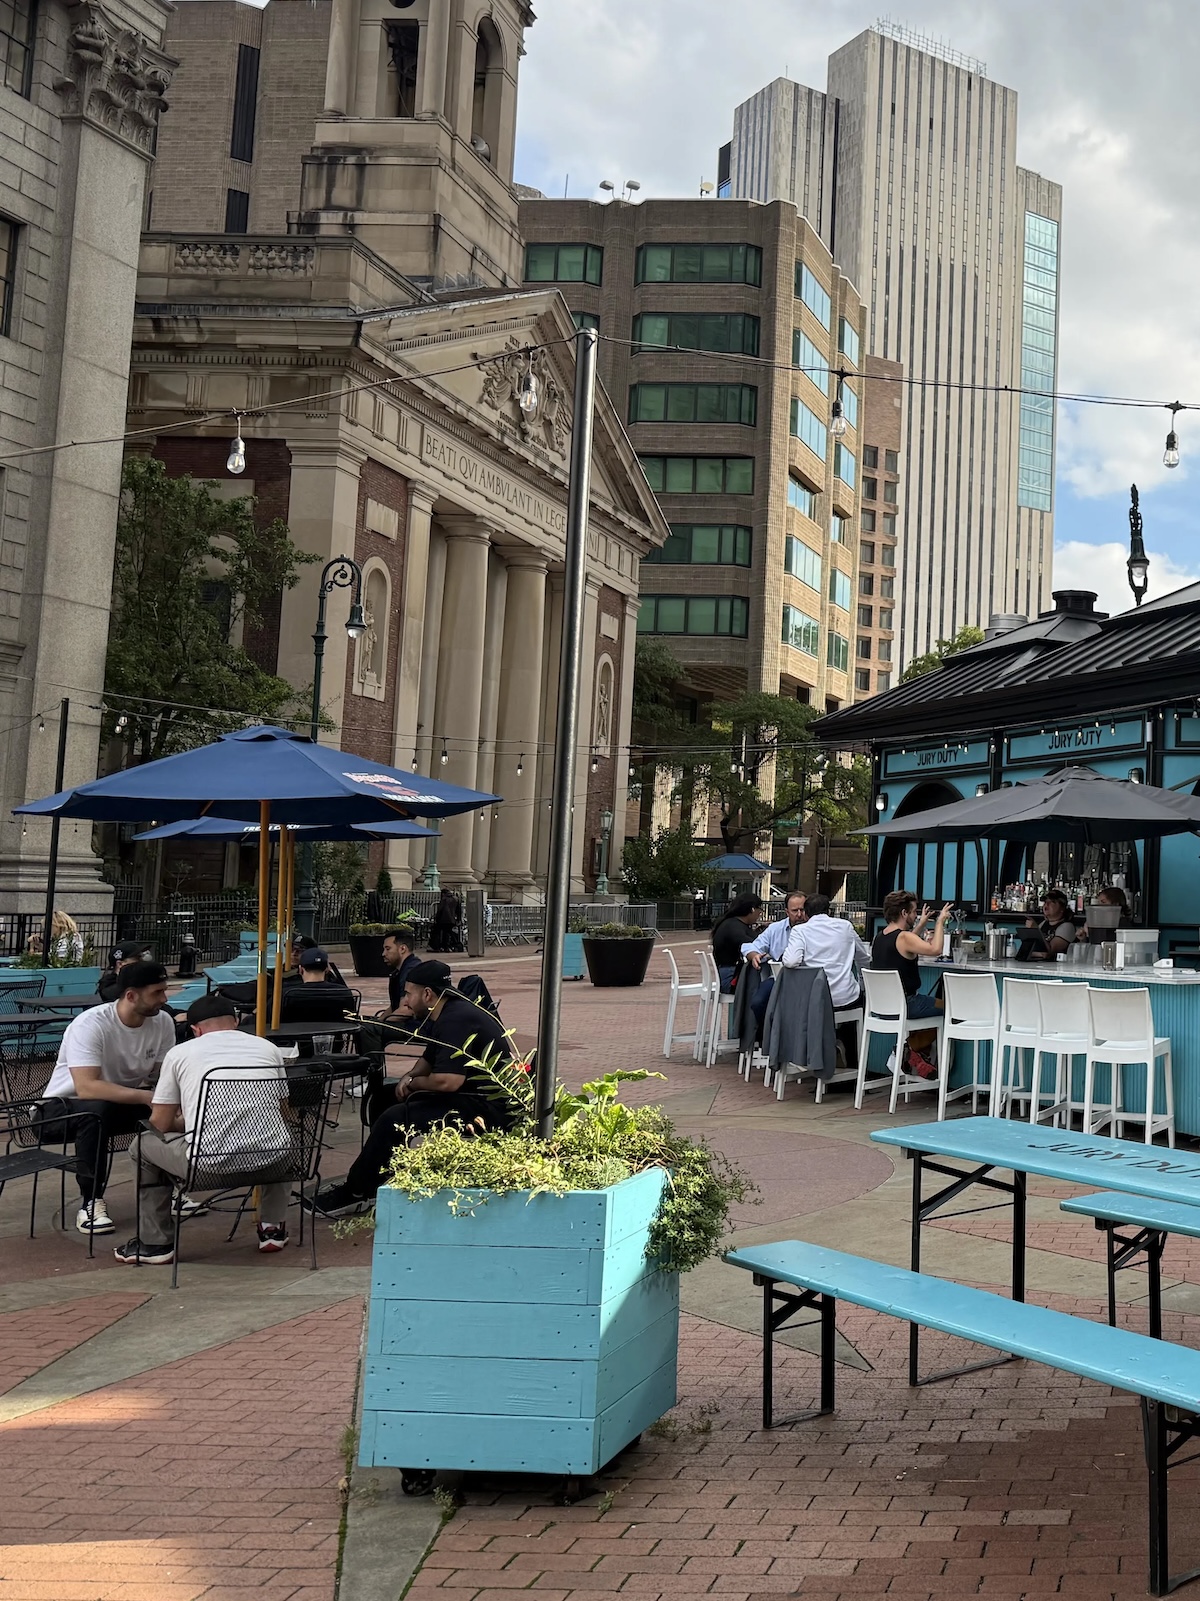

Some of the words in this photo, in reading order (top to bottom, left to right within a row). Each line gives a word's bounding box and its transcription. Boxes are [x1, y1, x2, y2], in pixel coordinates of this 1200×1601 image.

[425, 434, 457, 470] BEATI
[459, 456, 478, 482] QVI
[479, 467, 532, 513] AMBVLANT
[533, 500, 544, 521] IN
[546, 507, 566, 533] LEGE
[1048, 732, 1074, 750] JURY
[1074, 729, 1102, 747] DUTY
[917, 752, 936, 766] JURY
[937, 749, 959, 763] DUTY
[1027, 1142, 1142, 1162] JURY
